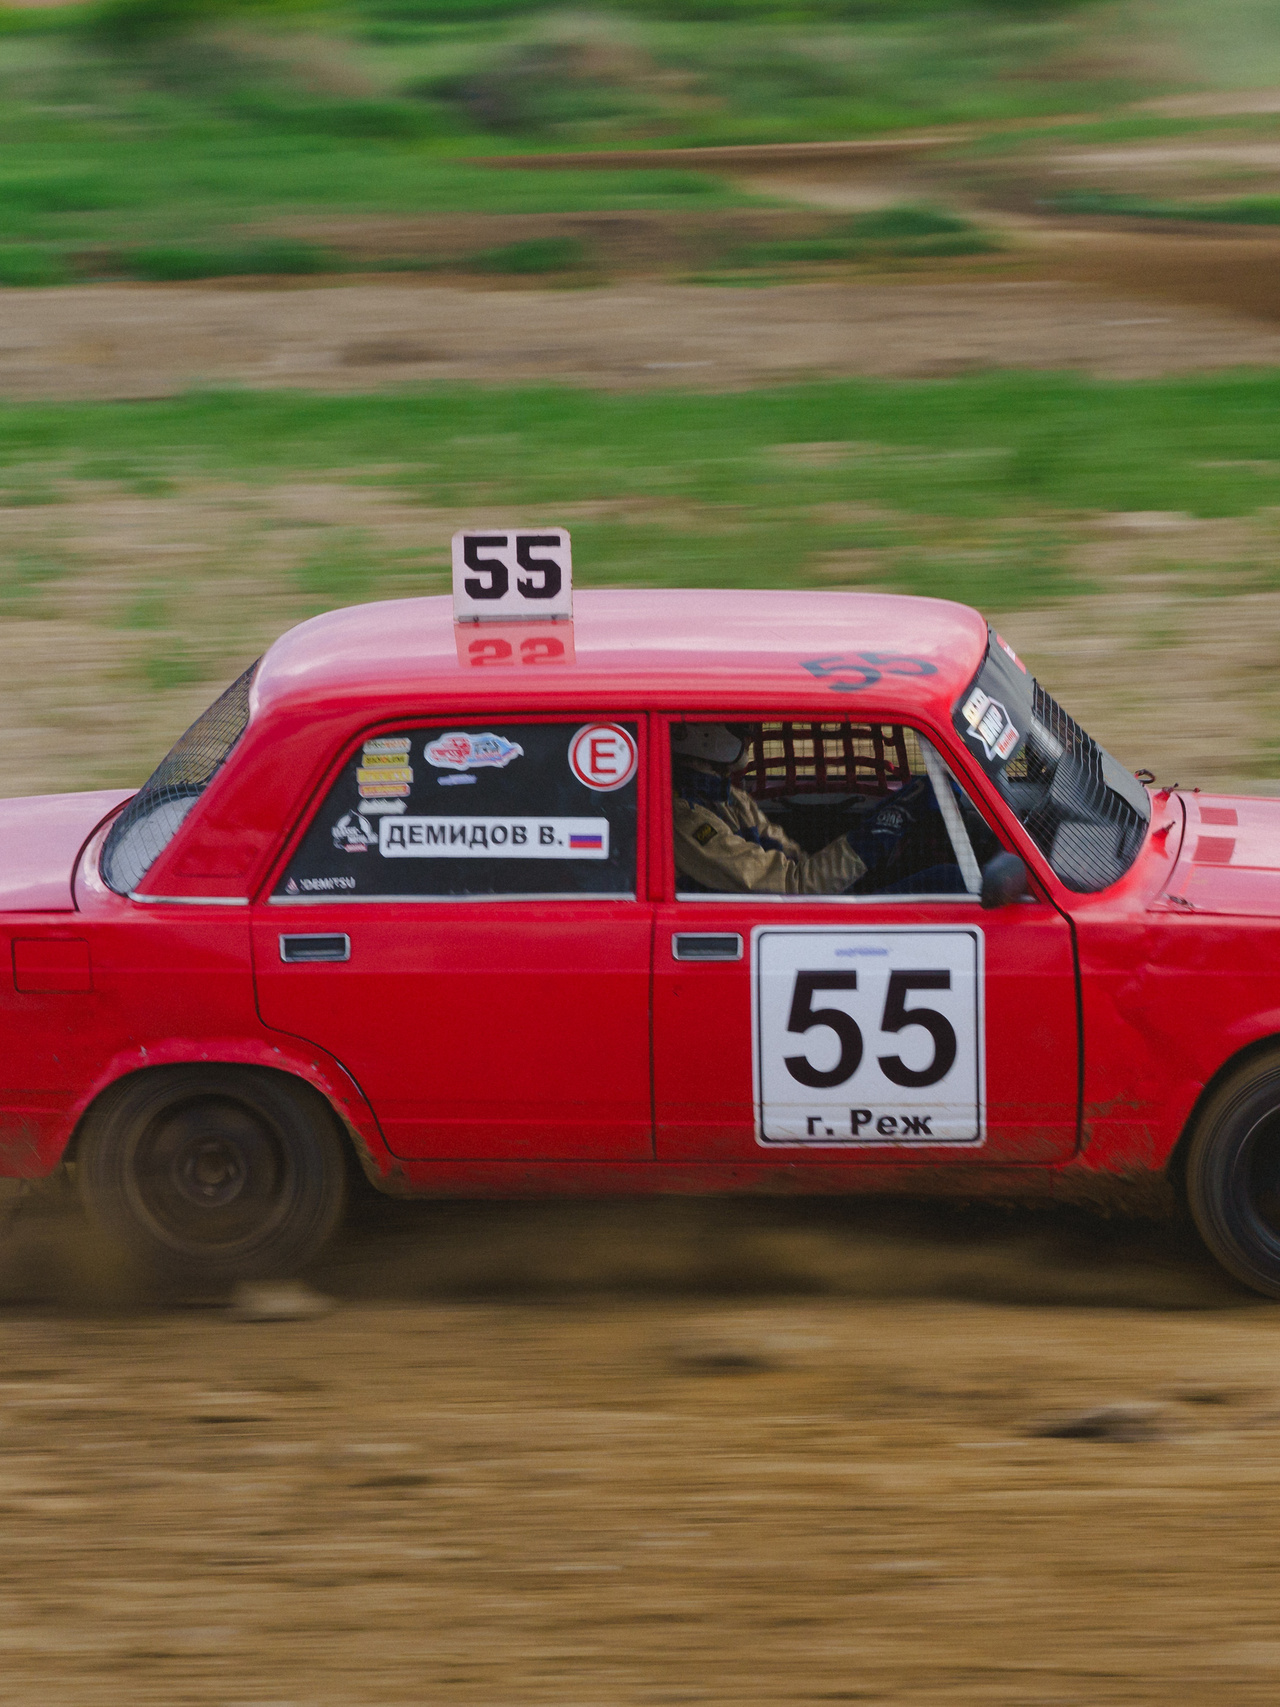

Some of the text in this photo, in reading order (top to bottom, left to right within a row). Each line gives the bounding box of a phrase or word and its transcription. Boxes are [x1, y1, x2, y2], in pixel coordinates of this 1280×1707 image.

[464, 536, 561, 599] 55
[800, 651, 938, 692] 55
[591, 739, 616, 773] E
[386, 824, 528, 850] ДЕМИДОВ
[539, 825, 563, 846] В.
[784, 970, 957, 1088] 55
[806, 1109, 933, 1136] г. Реж
